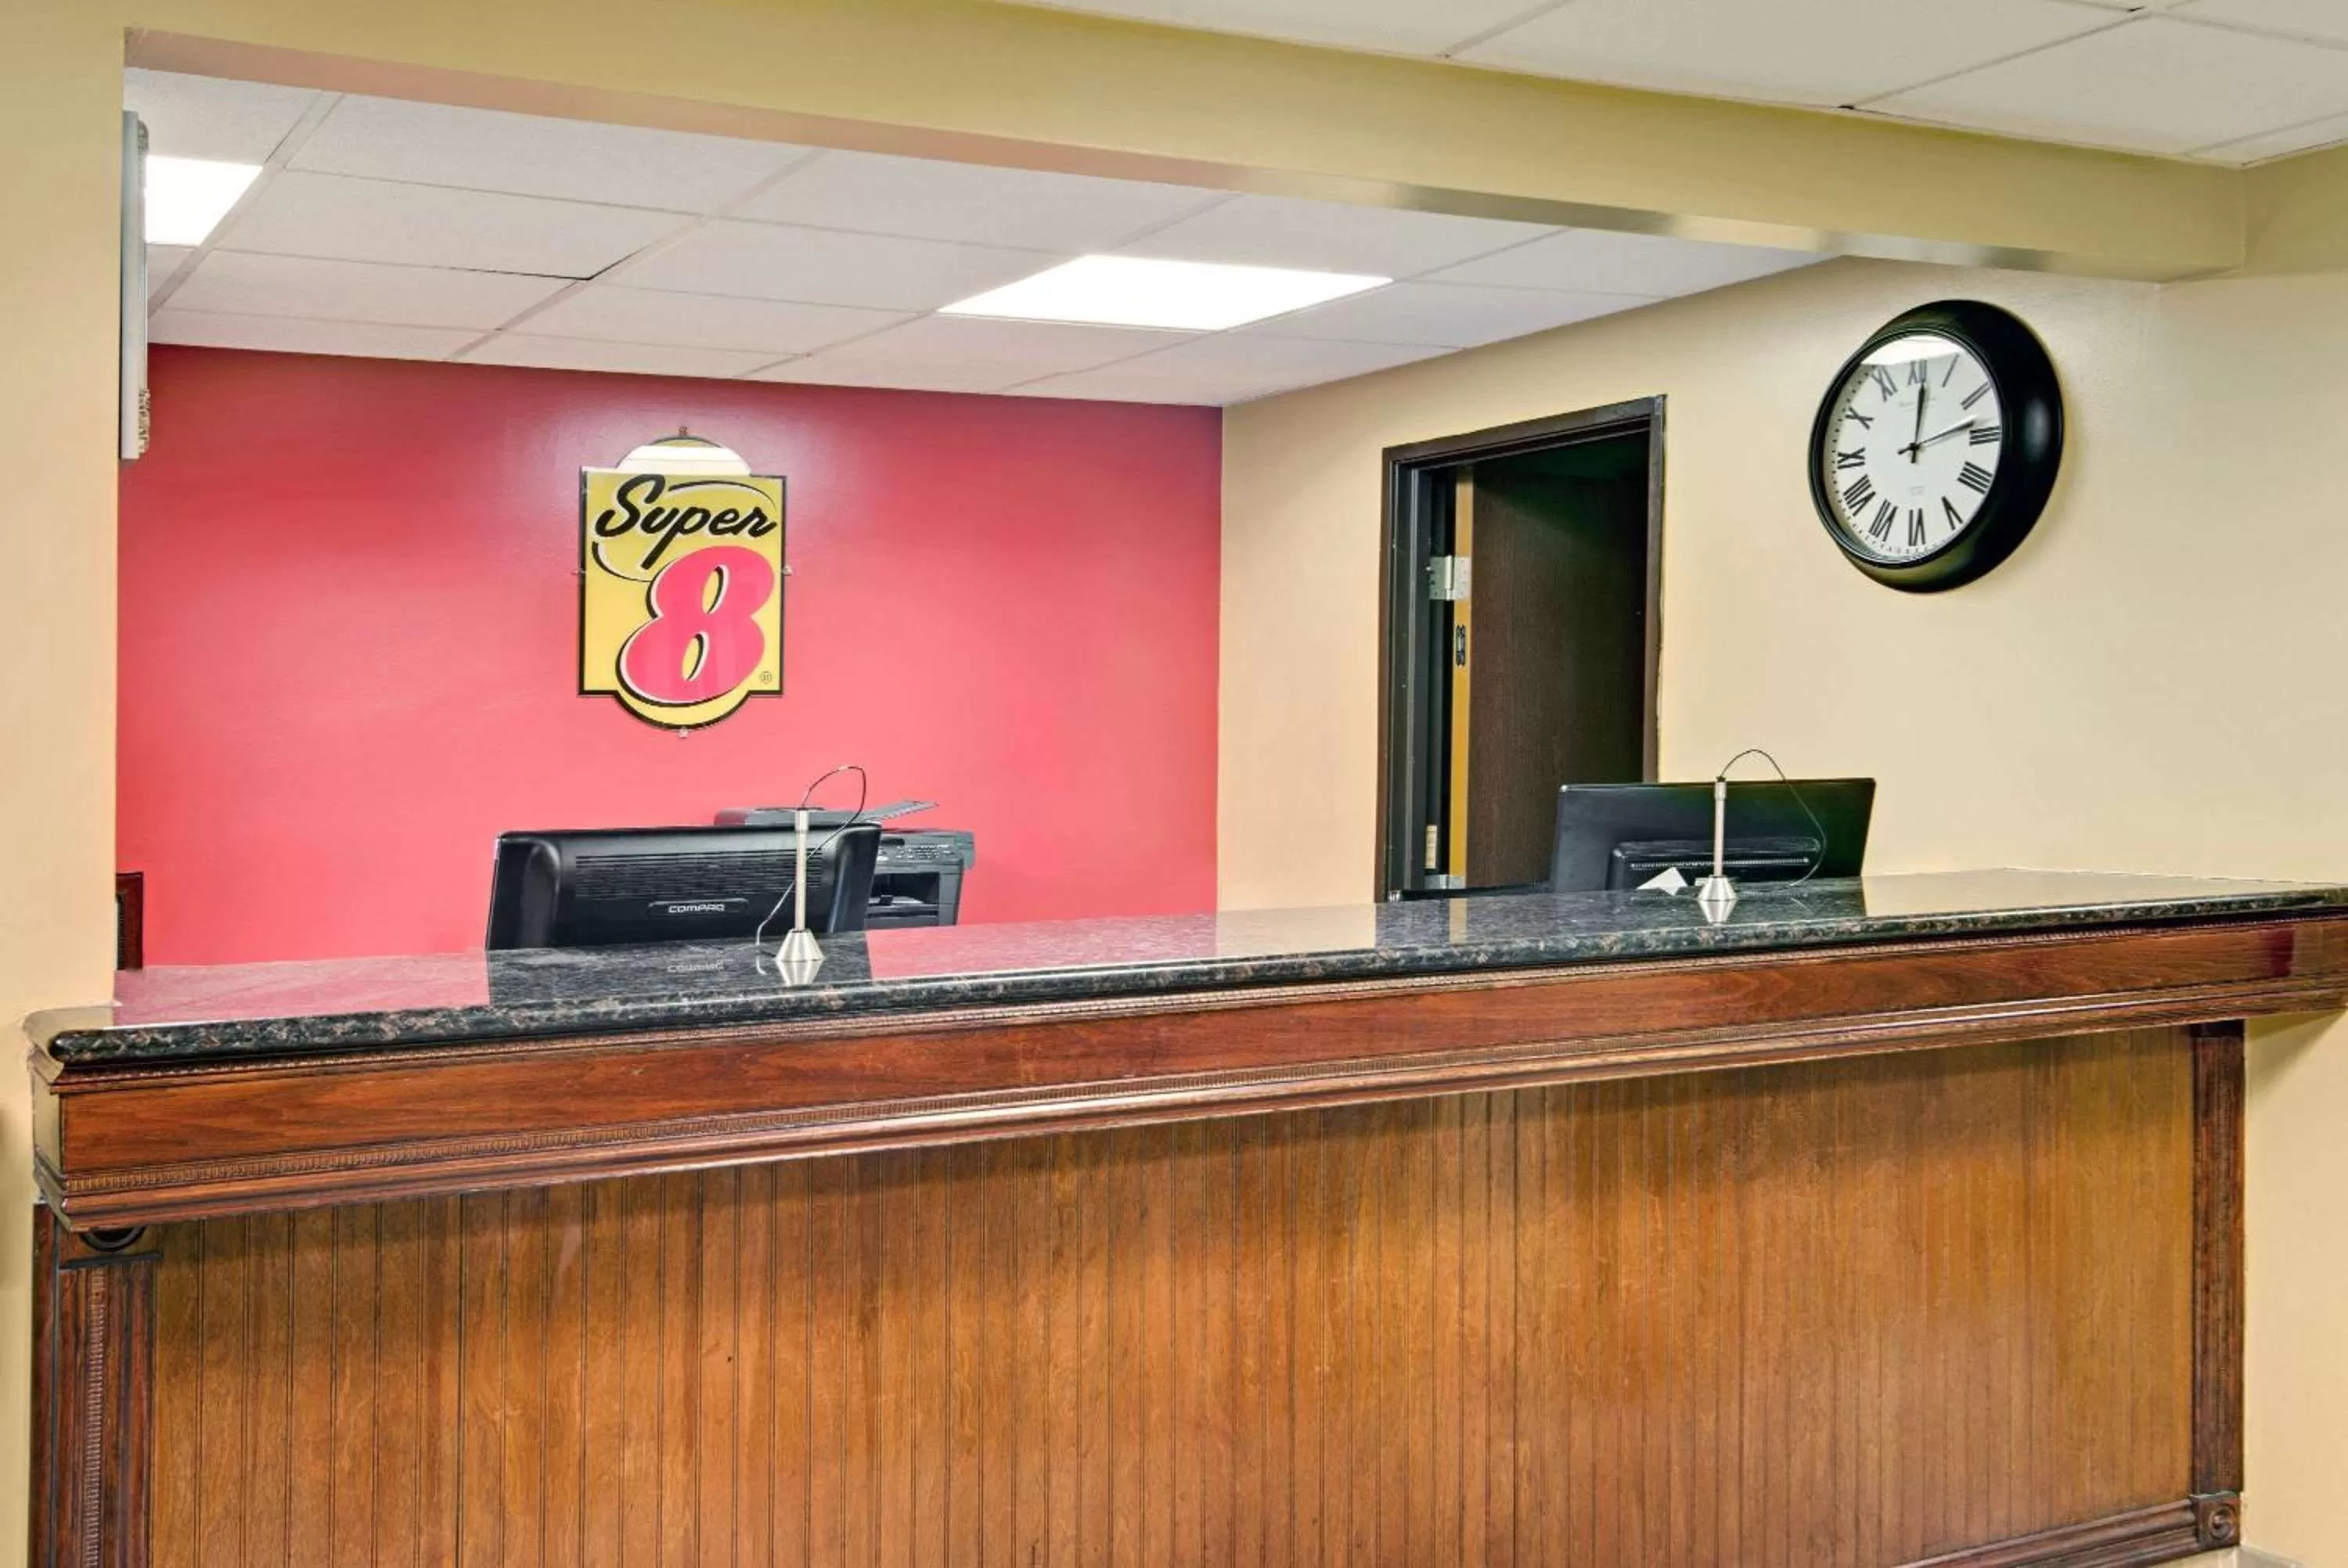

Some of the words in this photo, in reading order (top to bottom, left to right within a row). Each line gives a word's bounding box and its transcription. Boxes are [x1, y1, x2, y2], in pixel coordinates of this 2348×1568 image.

[1960, 381, 1992, 411] II
[1845, 407, 1874, 430] X
[1969, 426, 2000, 446] III
[594, 473, 777, 570] Super
[615, 545, 775, 707] 8
[668, 904, 725, 913] COMPAQ
